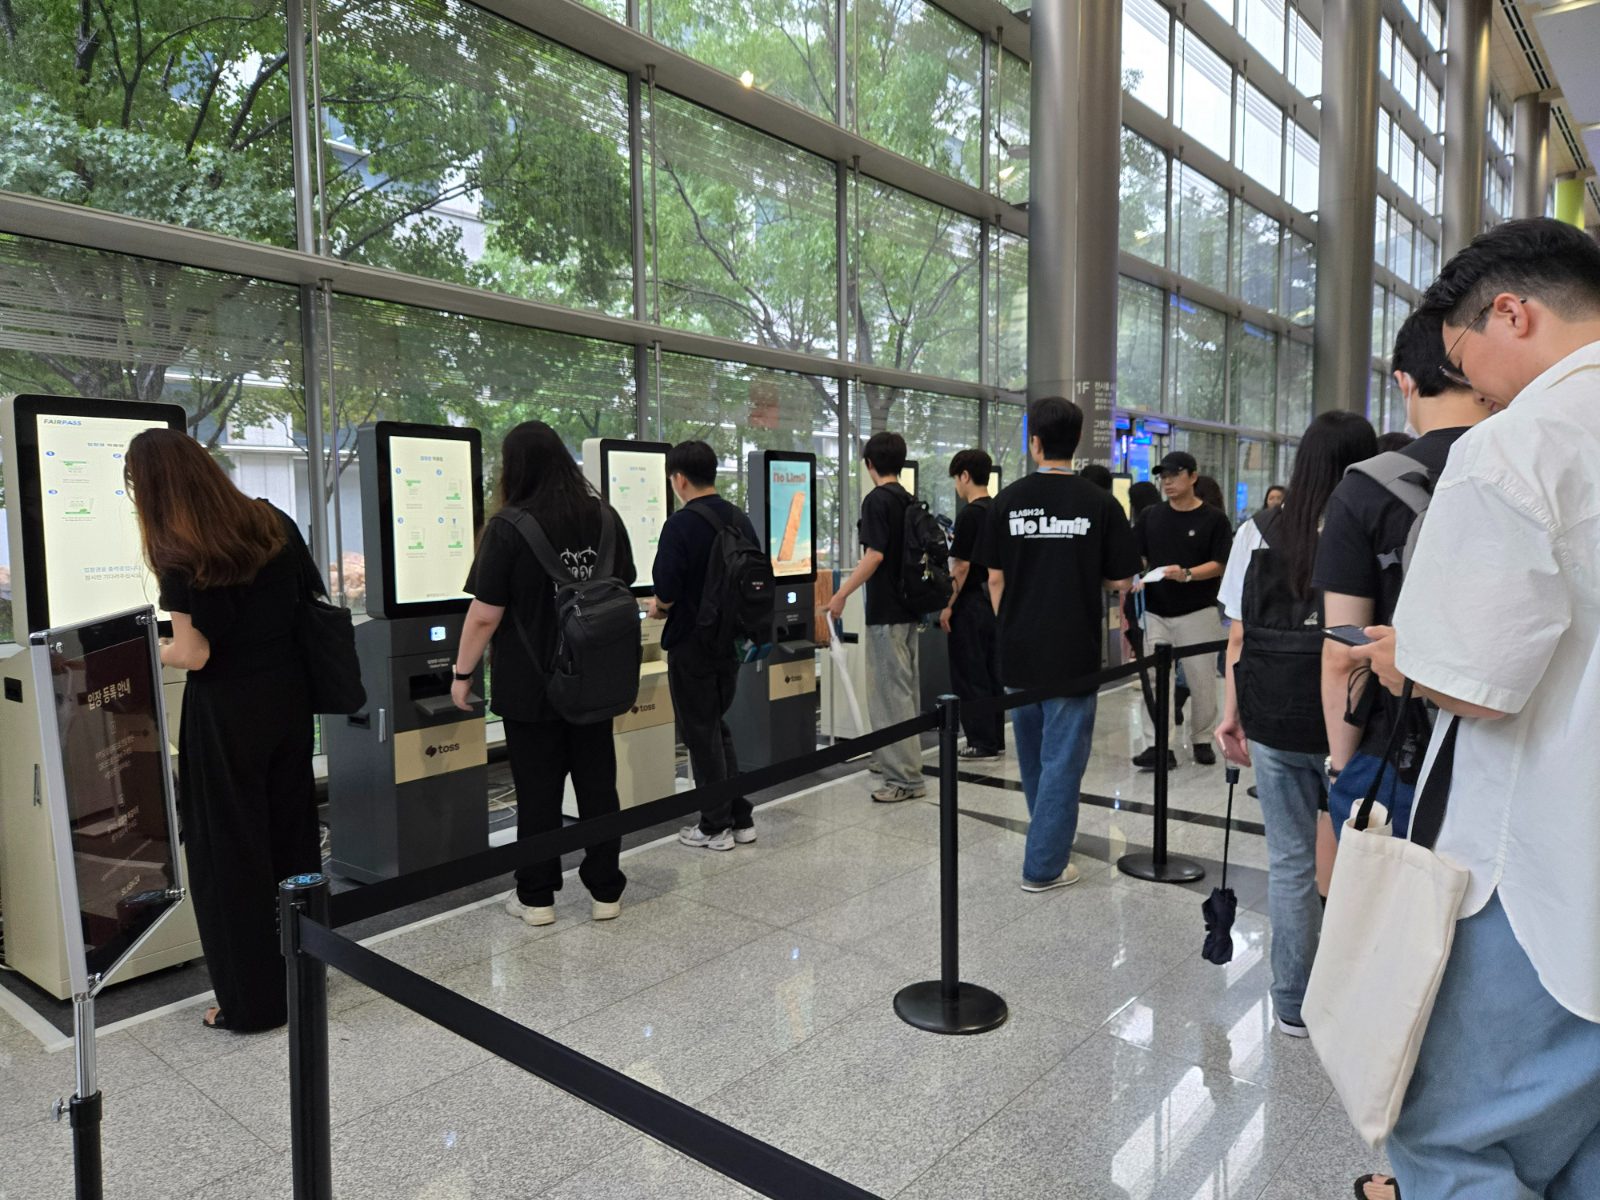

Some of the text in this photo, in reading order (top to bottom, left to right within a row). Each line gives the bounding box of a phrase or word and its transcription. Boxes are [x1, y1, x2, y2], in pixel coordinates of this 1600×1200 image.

[1076, 381, 1090, 395] 1F
[43, 418, 82, 426] FAIRPASS
[1039, 516, 1091, 535] Limit
[87, 677, 131, 711] 입장 등록 안내
[640, 703, 656, 712] toss
[438, 743, 460, 754] toss
